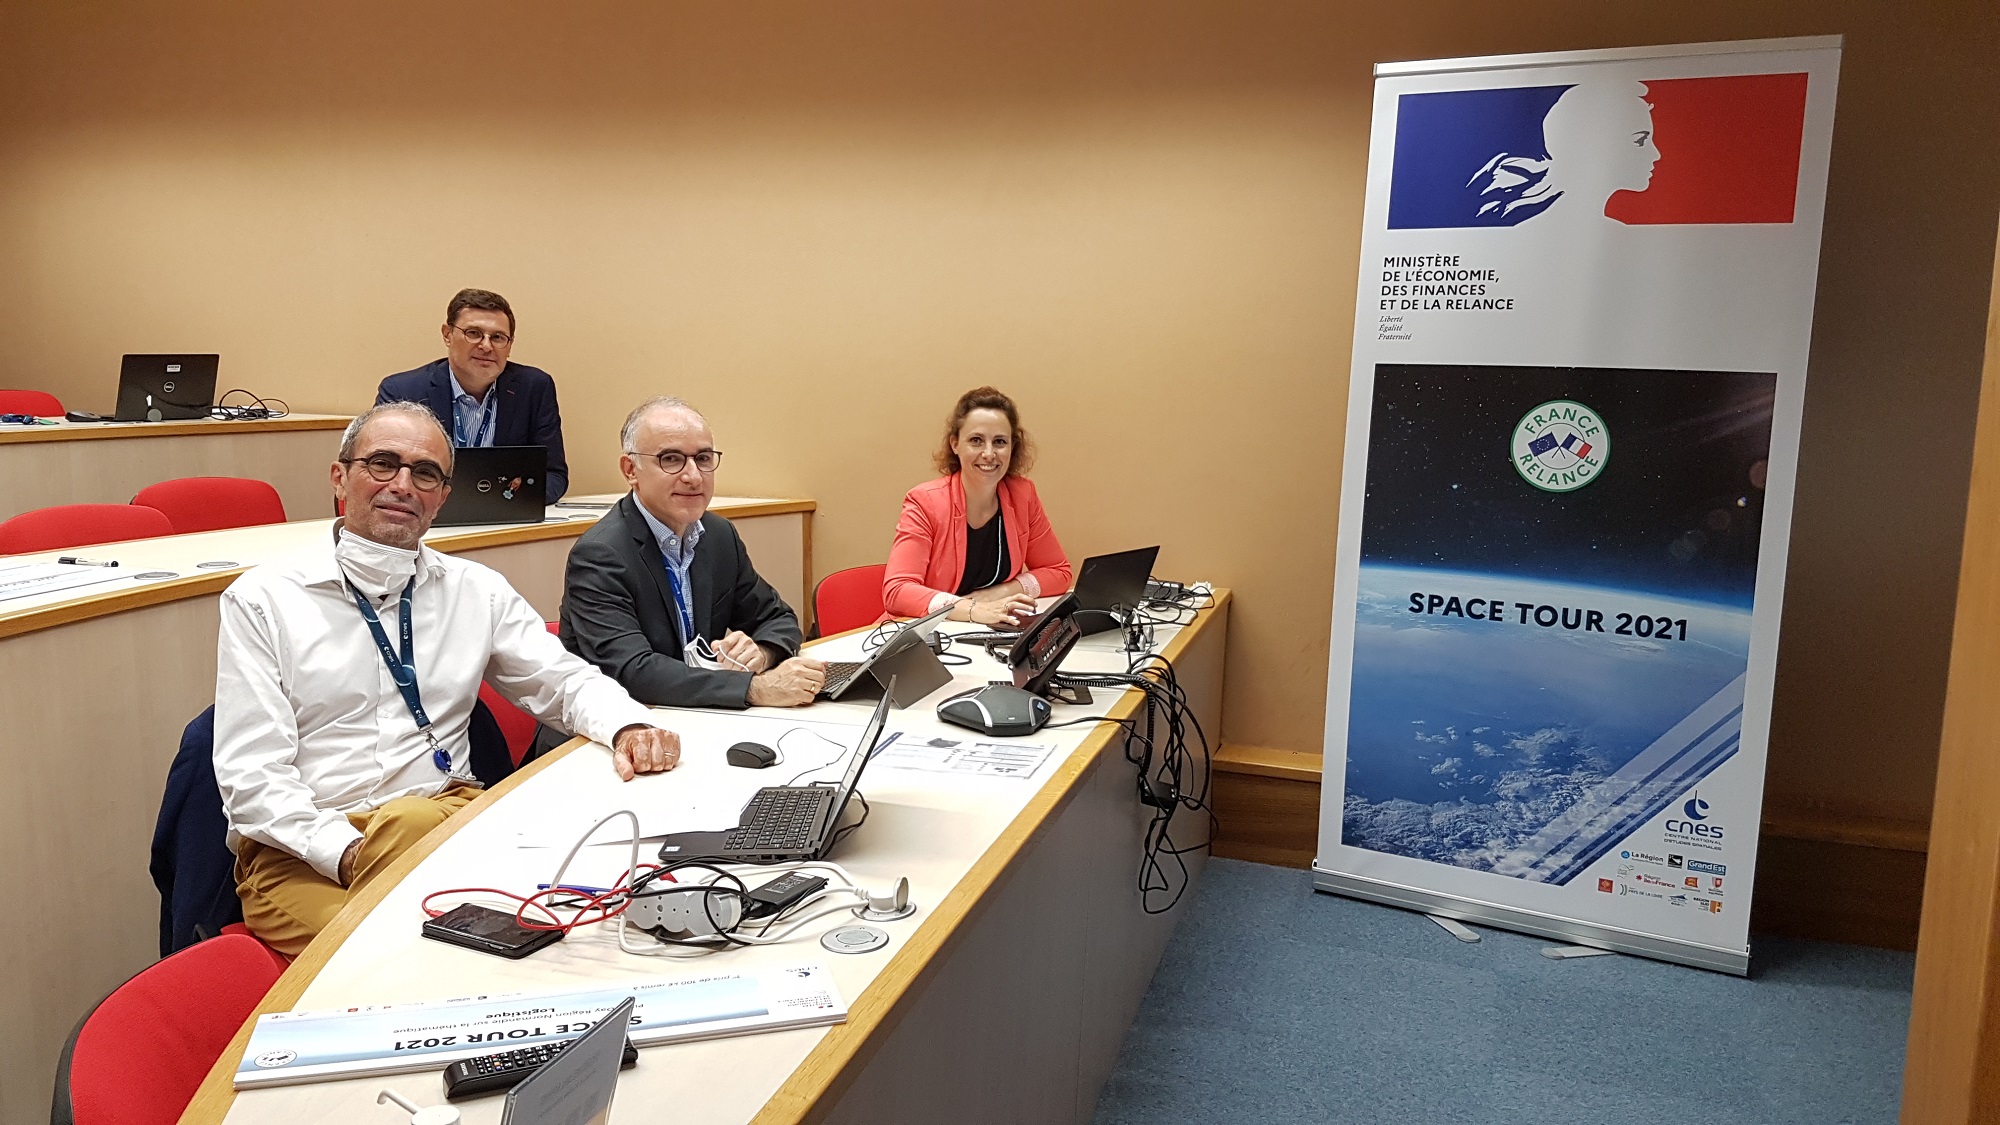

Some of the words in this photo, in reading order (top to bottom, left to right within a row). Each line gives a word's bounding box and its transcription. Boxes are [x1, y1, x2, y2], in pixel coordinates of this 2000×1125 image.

[1384, 254, 1460, 267] MINISTÈRE
[1382, 271, 1401, 282] DE
[1381, 285, 1408, 296] DES
[1412, 284, 1486, 296] FINANCES
[1380, 299, 1397, 310] ET
[1400, 299, 1419, 310] DE
[1423, 299, 1441, 310] LA
[1445, 298, 1514, 310] RELANCE
[1379, 315, 1403, 323] Liberté
[1378, 324, 1403, 332] Égalité
[1377, 333, 1412, 341] Fraternité
[1524, 408, 1600, 438] FRANCE
[1519, 453, 1599, 485] RELANCE
[1408, 592, 1504, 623] SPACE
[1514, 602, 1605, 633] TOUR
[1614, 612, 1688, 642] 2021
[1665, 819, 1723, 839] cnes
[1690, 836, 1722, 846] NATIONAL
[1640, 853, 1664, 863] Région
[486, 1008, 555, 1020] Logistique
[555, 1009, 592, 1019] Région
[491, 1015, 552, 1026] Normandie
[556, 1016, 643, 1035] SCE
[393, 1024, 457, 1035] thématique
[467, 1027, 545, 1043] TOUR
[394, 1036, 457, 1051] 2021
